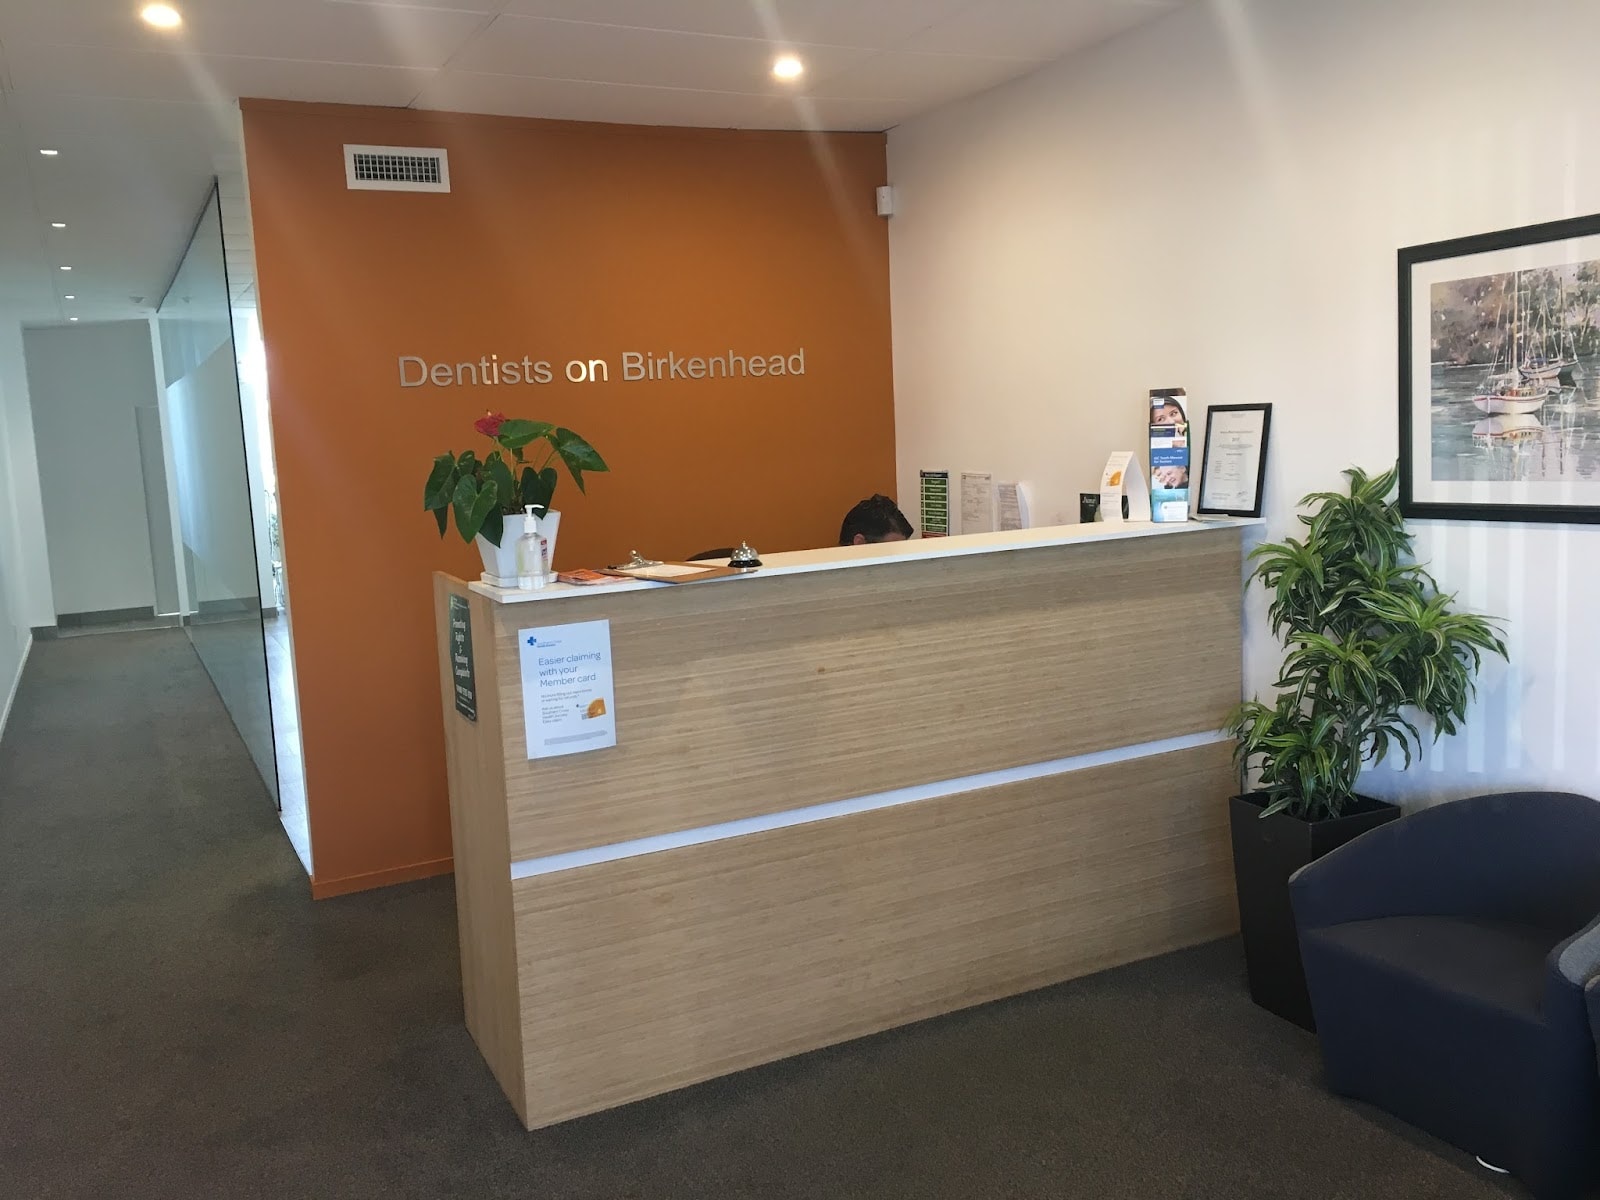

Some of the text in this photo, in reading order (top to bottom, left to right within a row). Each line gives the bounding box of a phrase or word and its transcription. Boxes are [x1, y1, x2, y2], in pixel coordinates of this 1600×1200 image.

[399, 348, 806, 388] Dentists on Birkenhead
[538, 652, 601, 666] Easier claiming
[539, 666, 578, 677] with your
[540, 673, 597, 688] Member card
